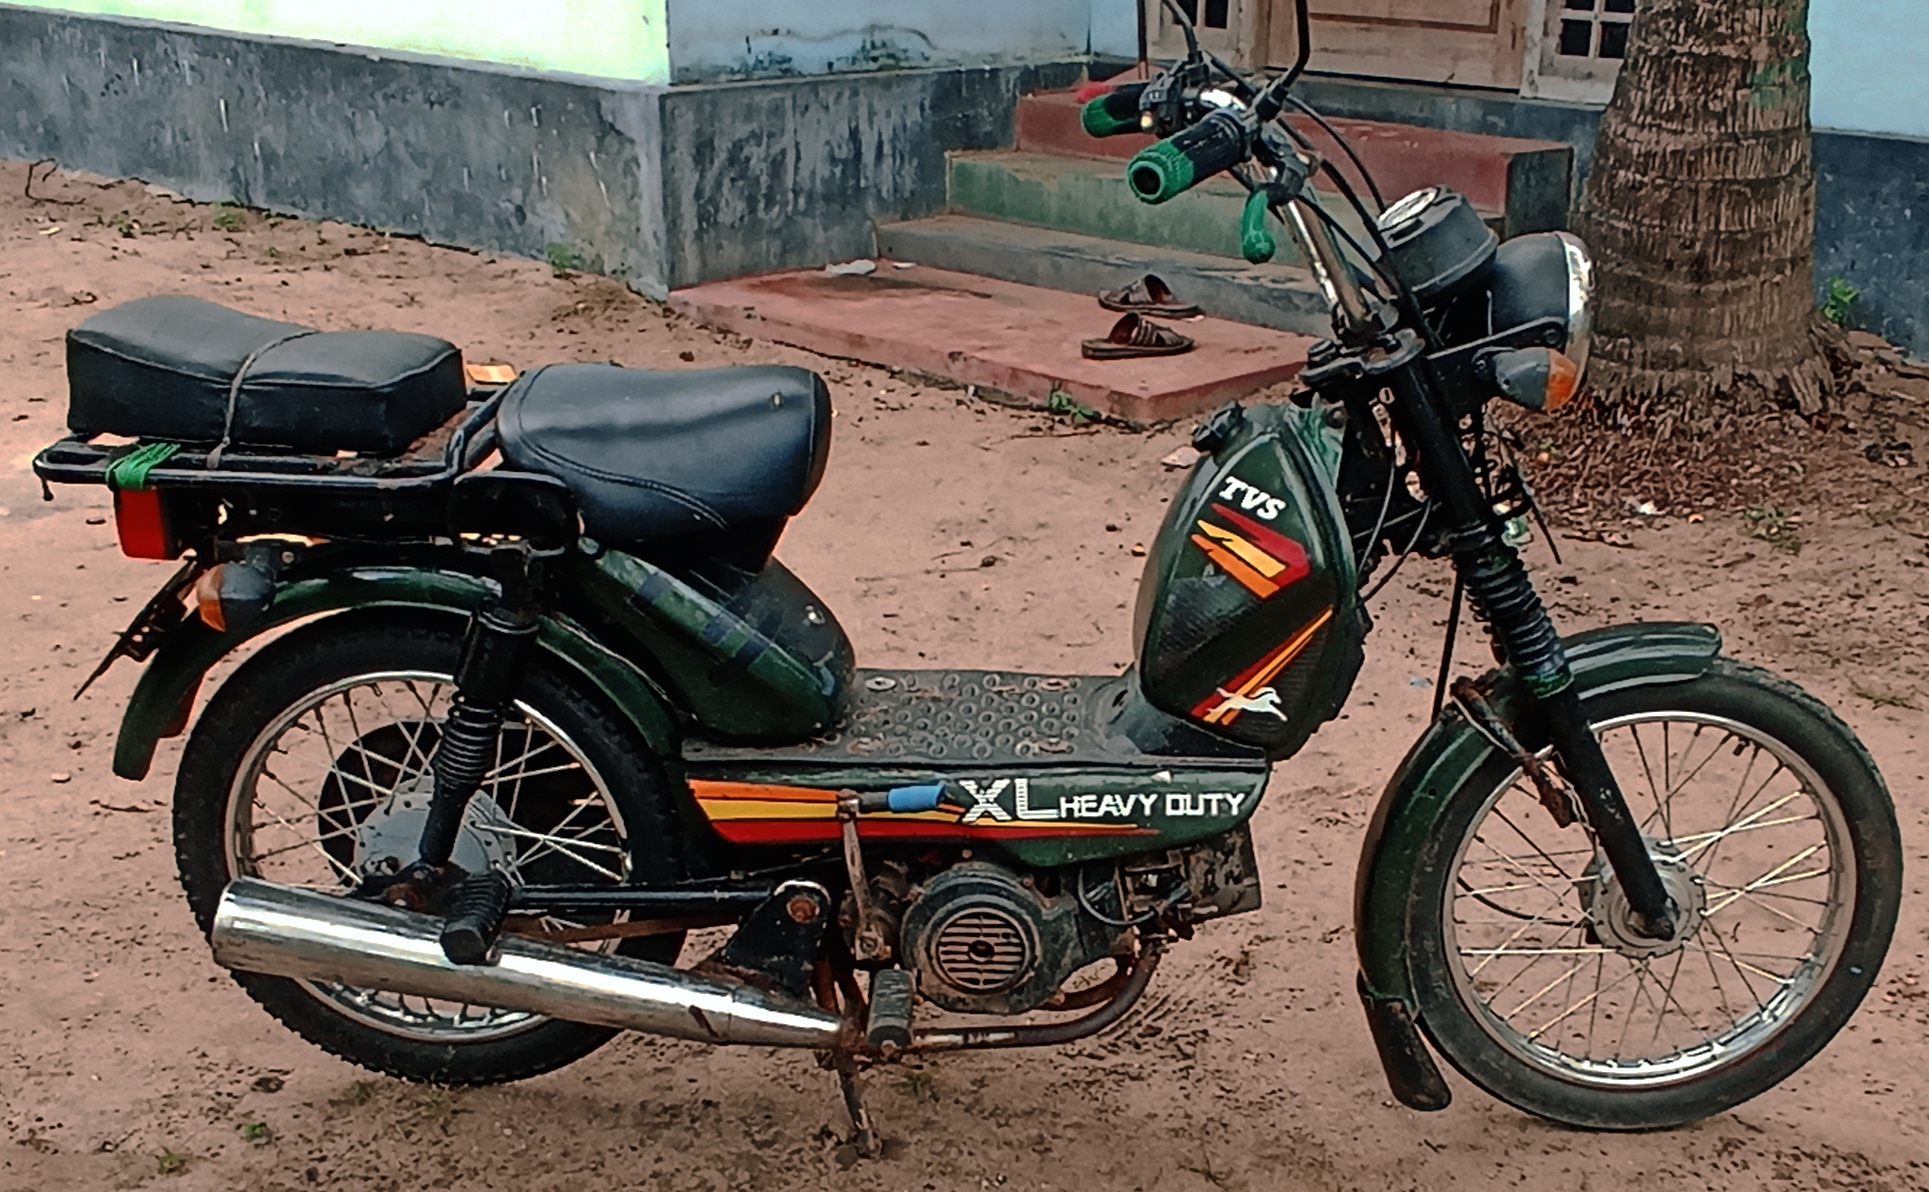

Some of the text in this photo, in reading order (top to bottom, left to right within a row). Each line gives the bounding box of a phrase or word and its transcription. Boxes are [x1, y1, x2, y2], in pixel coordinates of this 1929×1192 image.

[1219, 476, 1287, 520] TVS
[959, 778, 1245, 823] XL HEAVY DUTY
